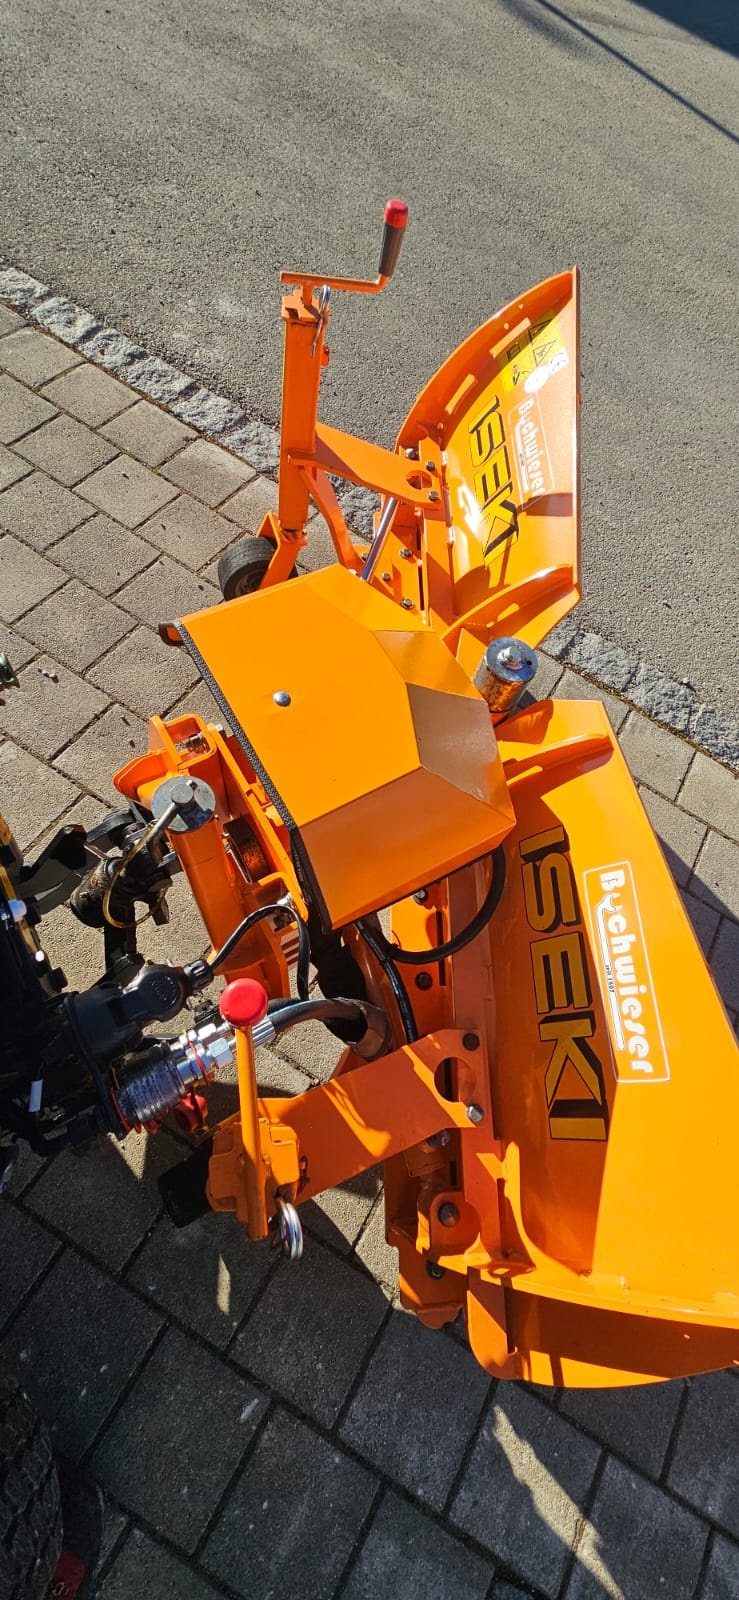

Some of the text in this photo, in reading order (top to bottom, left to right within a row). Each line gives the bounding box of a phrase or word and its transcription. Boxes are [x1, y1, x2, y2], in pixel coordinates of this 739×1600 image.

[468, 395, 518, 567] ISEKI
[518, 397, 546, 497] Buchwieser
[519, 824, 608, 1141] ISEKI
[600, 869, 654, 1074] Buchwieser
